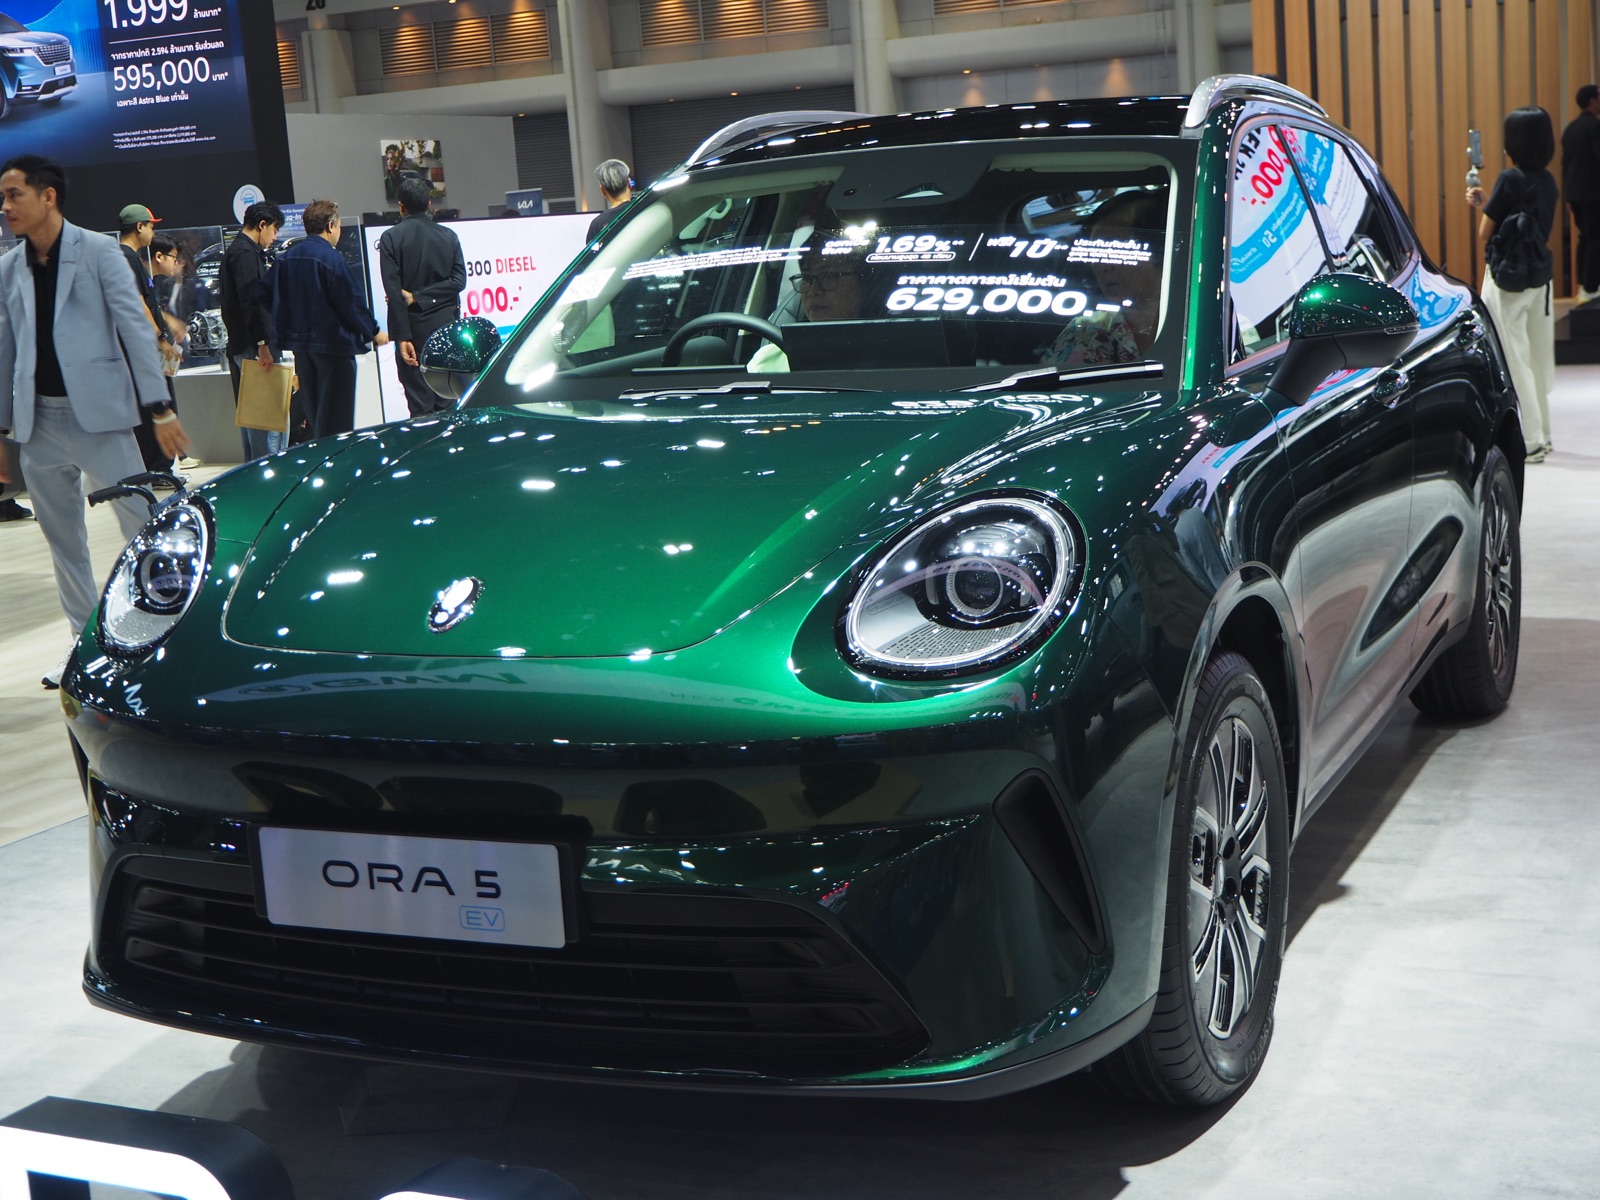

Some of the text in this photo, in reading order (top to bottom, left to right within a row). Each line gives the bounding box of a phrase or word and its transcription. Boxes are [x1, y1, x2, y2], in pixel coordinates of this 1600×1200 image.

[104, 0, 189, 28] 1.999
[151, 46, 169, 56] 2.594
[113, 56, 210, 91] 595,000
[138, 96, 155, 105] Astra
[155, 95, 170, 103] Blue
[467, 256, 537, 277] 300 DIESEL
[322, 859, 501, 899] ORA 5
[465, 910, 499, 928] EV
